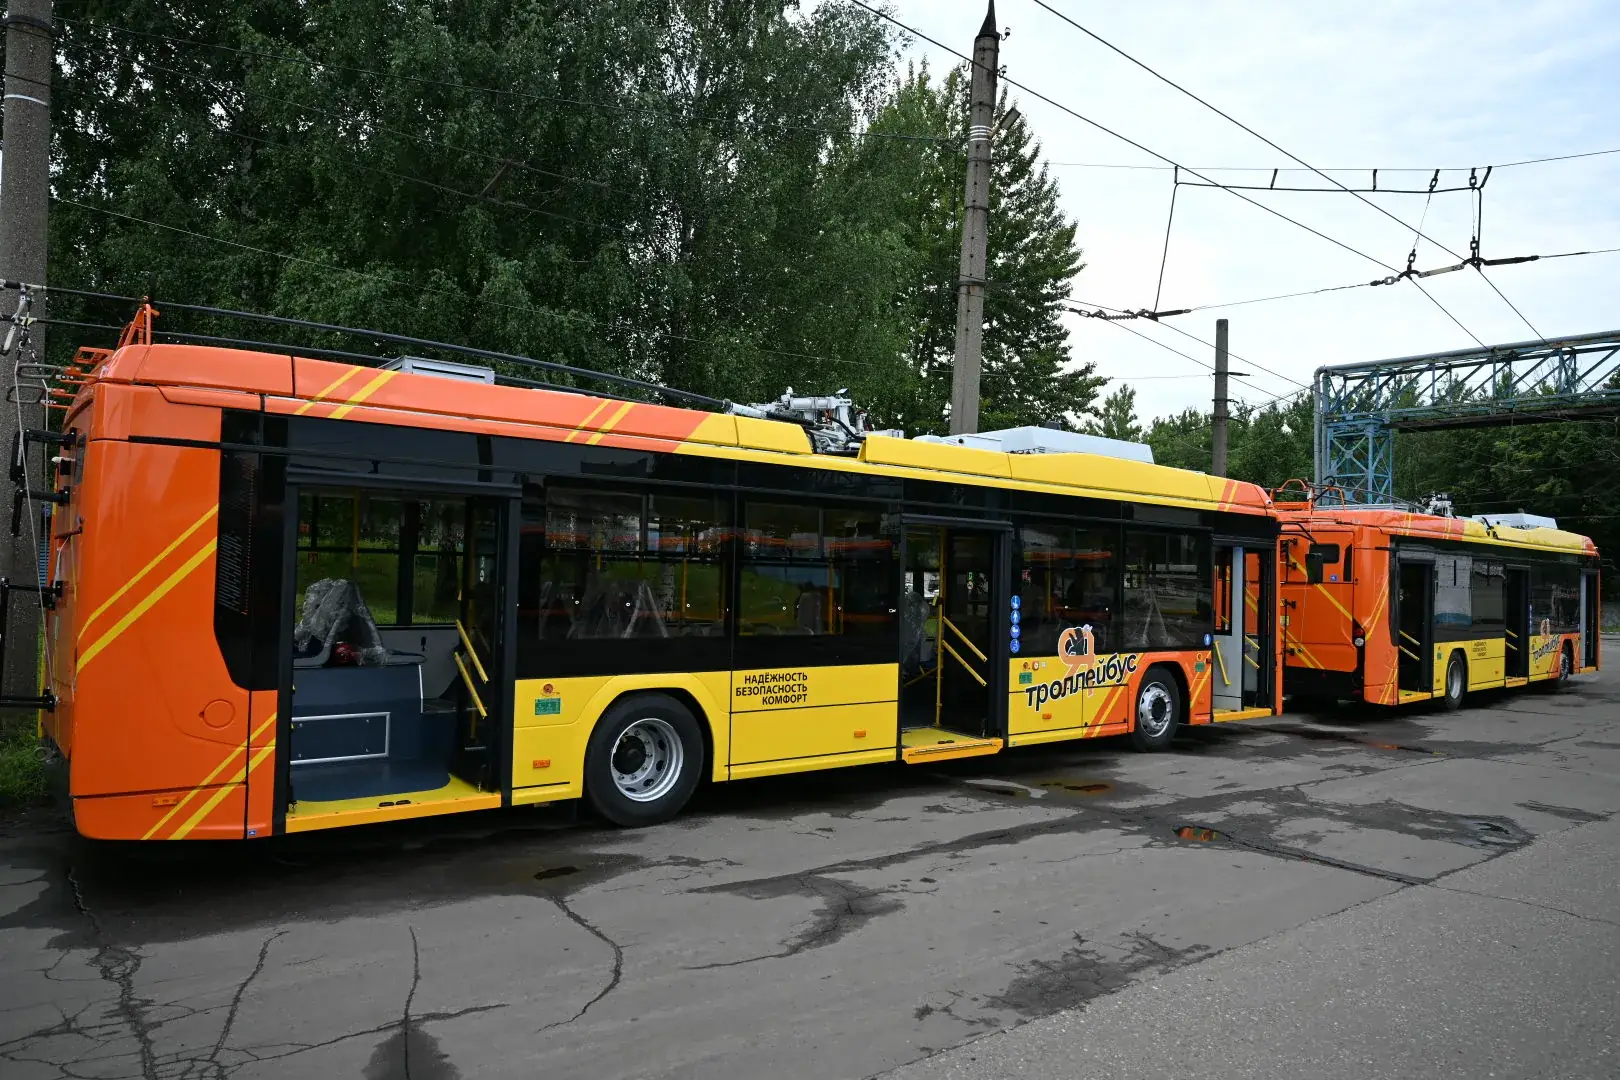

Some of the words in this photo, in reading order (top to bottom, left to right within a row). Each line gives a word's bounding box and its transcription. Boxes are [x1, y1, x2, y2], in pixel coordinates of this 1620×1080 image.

[744, 672, 808, 685] НАДЁЖНОСТЬ
[1025, 653, 1137, 712] троллейбус
[735, 683, 808, 696] БЕЗОПАСНОСТЬ
[762, 693, 808, 705] КОМФОРТ
